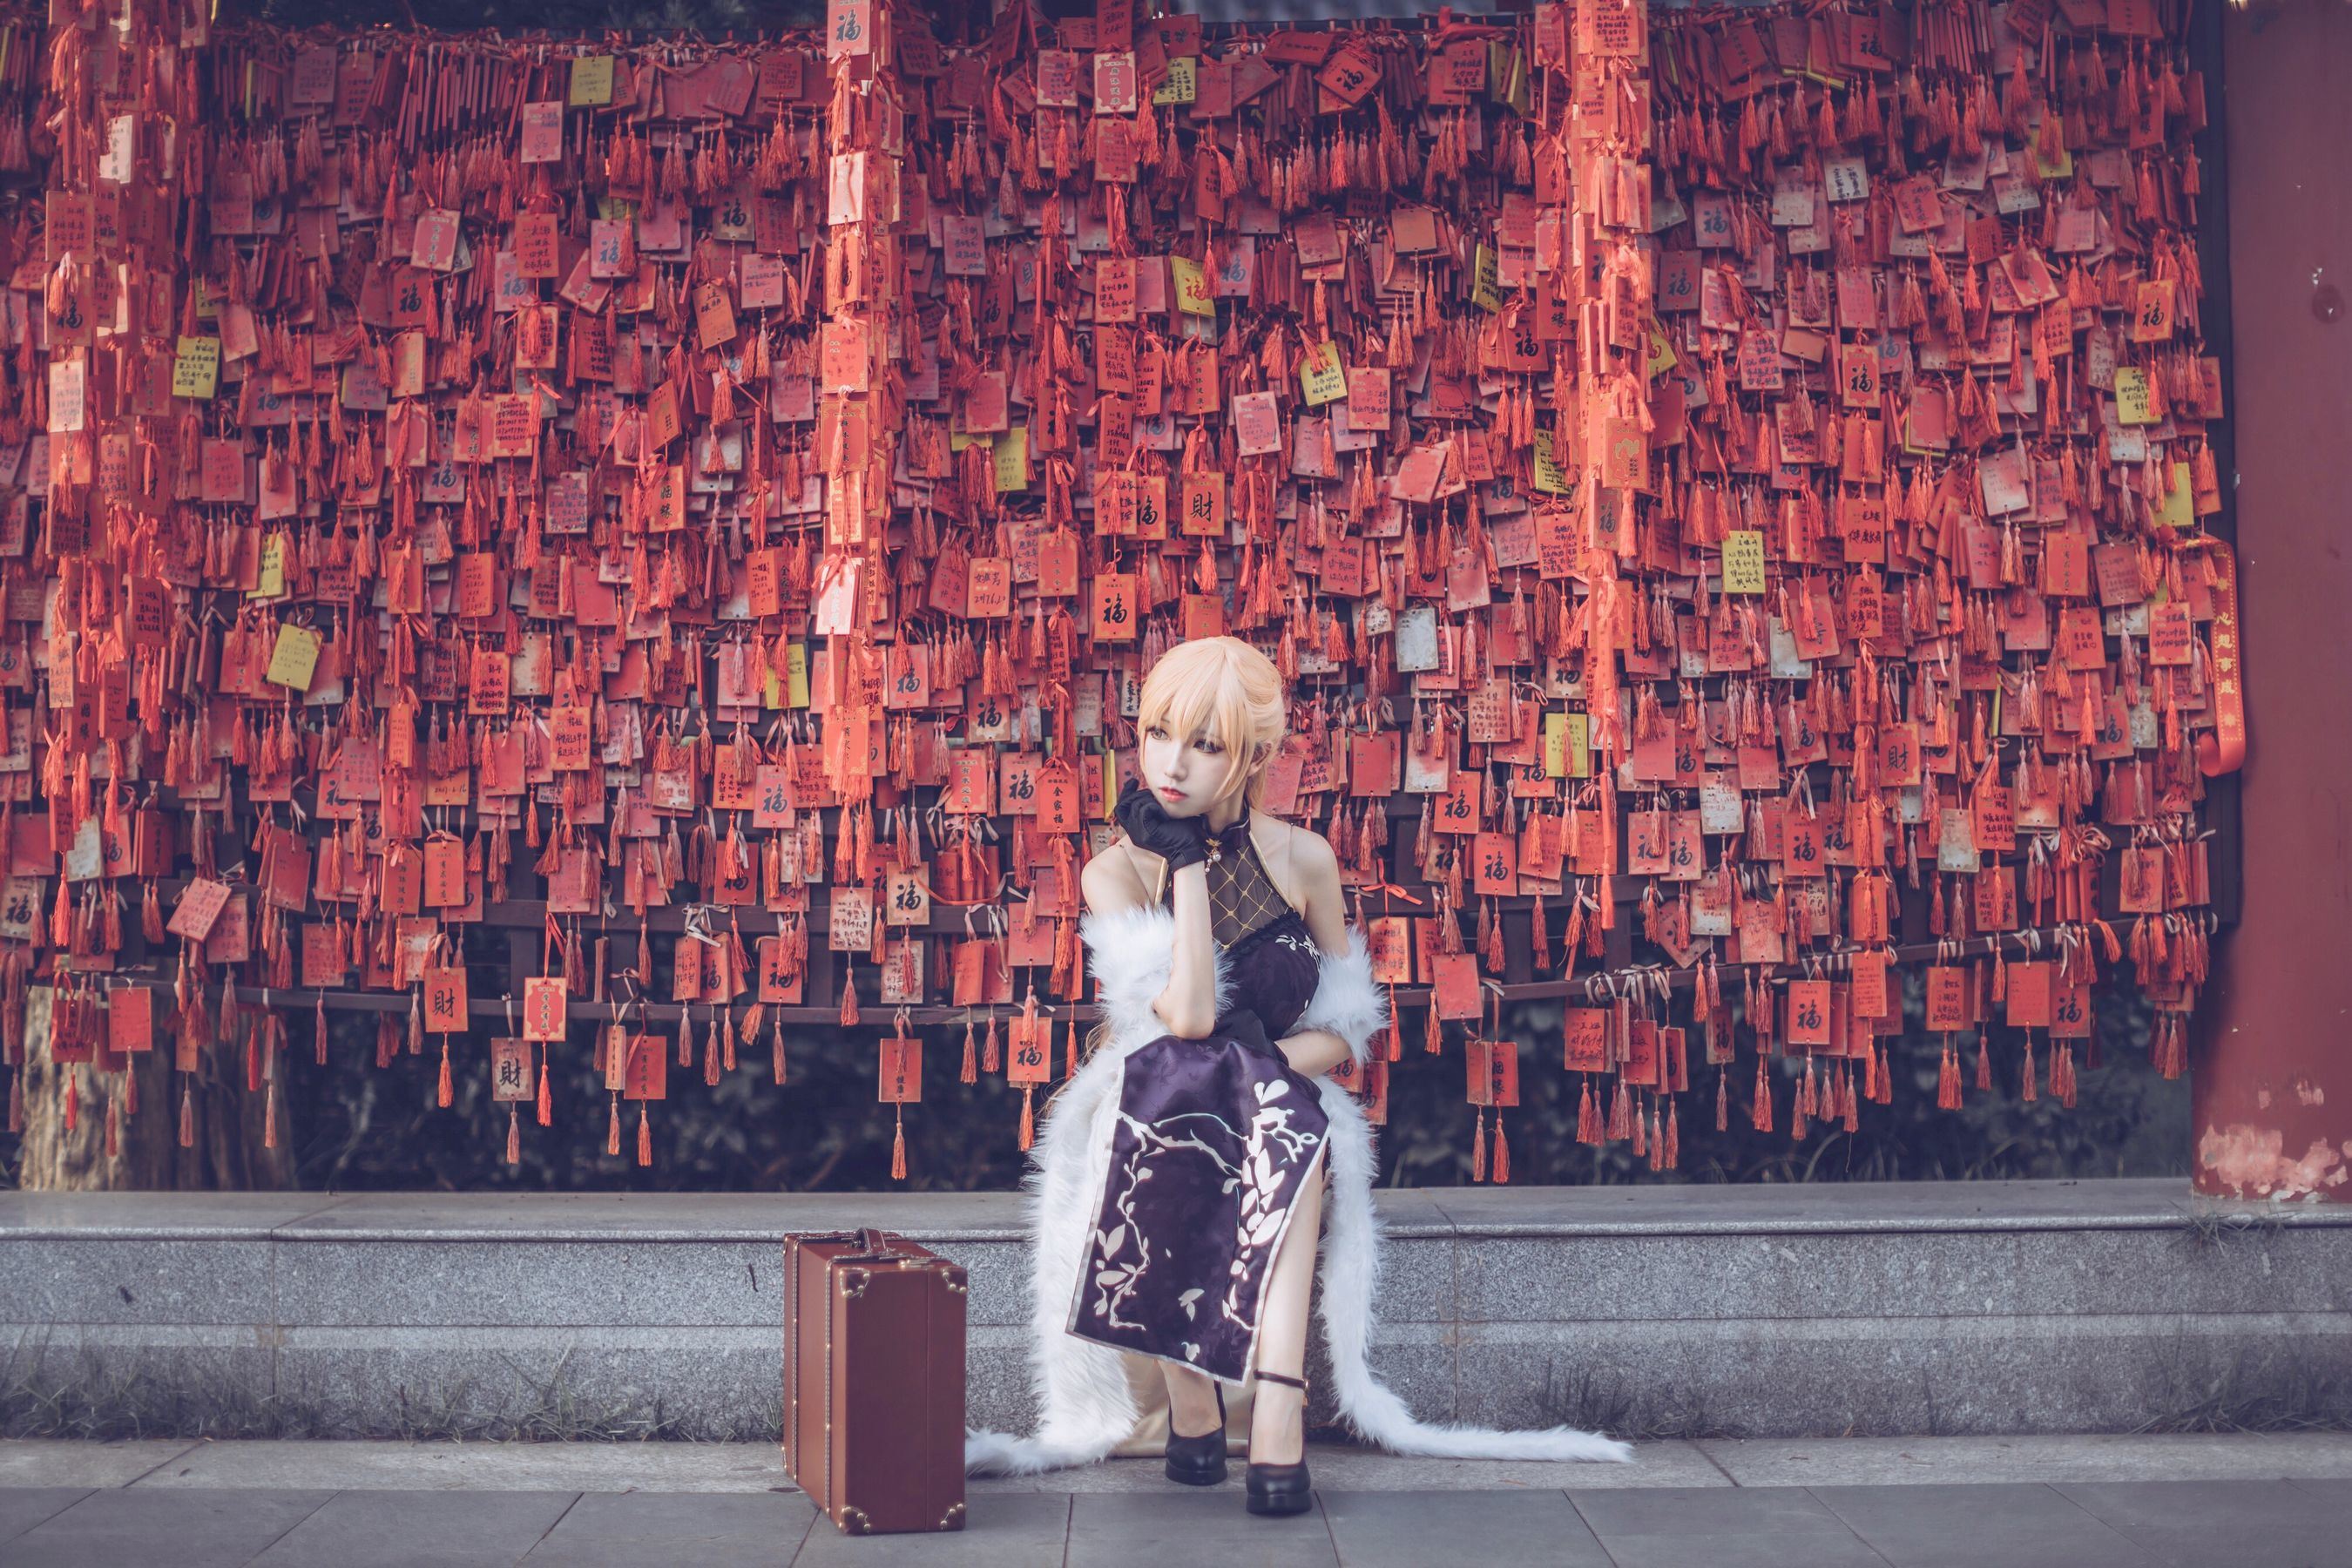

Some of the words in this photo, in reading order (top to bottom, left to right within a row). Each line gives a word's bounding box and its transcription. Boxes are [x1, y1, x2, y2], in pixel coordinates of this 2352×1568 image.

[836, 10, 862, 43] 福
[1861, 32, 1882, 57] 福
[1335, 66, 1365, 92] 福
[722, 200, 747, 227] 福
[1703, 209, 1728, 233] 福
[503, 273, 528, 298] 福
[1668, 269, 1692, 297] 福
[398, 287, 422, 314] 福
[983, 293, 1001, 324] 福
[2143, 301, 2165, 327] 福
[1515, 331, 1539, 358] 福
[1879, 335, 1901, 359] 福
[1851, 363, 1874, 392] 福
[432, 462, 456, 488] 福
[1491, 476, 1515, 500] 福
[1135, 496, 1159, 524] 福
[1190, 493, 1213, 523] 財
[1599, 502, 1616, 534] 福
[780, 565, 792, 601] 全家福
[1104, 593, 1128, 623] 福
[2216, 612, 2236, 695] 心想事成
[896, 667, 921, 694] 福
[977, 698, 1003, 727] 福
[1888, 747, 1908, 774] 財
[763, 784, 788, 813] 福
[961, 767, 972, 806] 有求必应
[1010, 770, 1035, 800] 福
[1052, 787, 1064, 824] 全家福
[1444, 793, 1471, 821] 福
[1670, 837, 1693, 866] 福
[1793, 833, 1816, 862] 福
[1485, 851, 1509, 882] 福
[4, 896, 32, 925] 福
[896, 883, 922, 911] 福
[432, 989, 455, 1018] 財
[1796, 999, 1821, 1030] 福
[2057, 993, 2083, 1023] 福
[498, 1058, 521, 1087] 財
